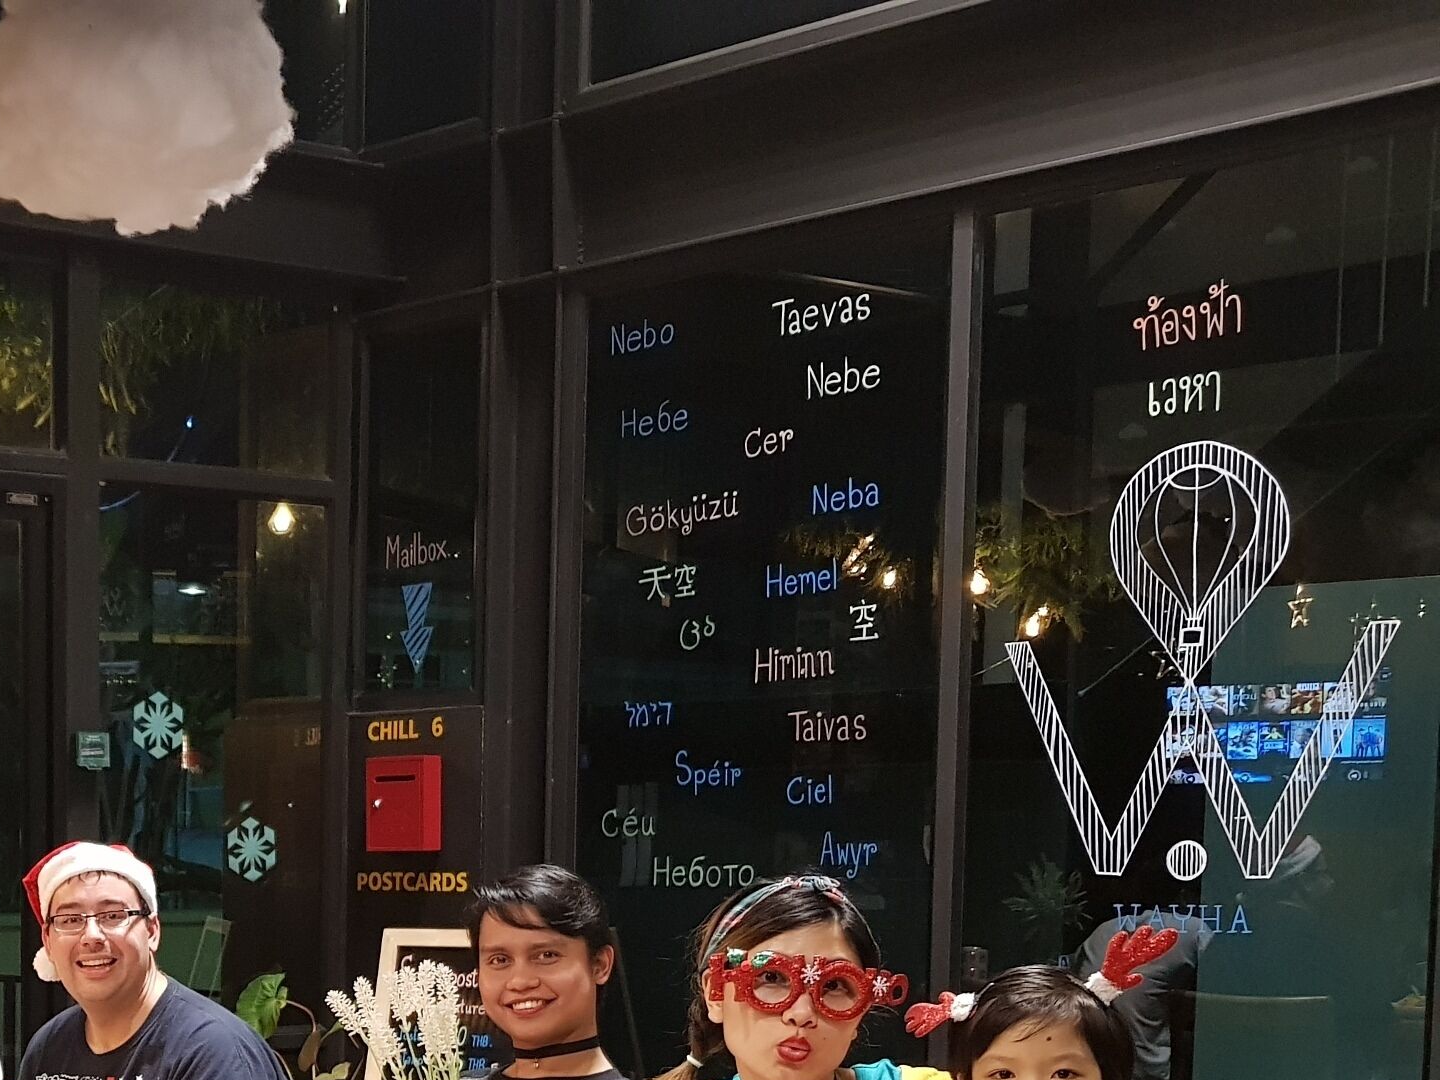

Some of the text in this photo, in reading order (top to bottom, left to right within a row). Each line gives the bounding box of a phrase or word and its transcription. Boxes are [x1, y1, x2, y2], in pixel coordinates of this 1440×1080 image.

[772, 293, 871, 336] Taevas
[1133, 279, 1242, 351] ท้องฟ้า
[611, 319, 675, 355] Nebo
[807, 357, 881, 399] Nebe
[1148, 370, 1221, 416] เวหา
[745, 427, 794, 458] Cer
[626, 491, 739, 536] Gökyüzü
[812, 478, 880, 515] Neba
[638, 564, 697, 600] 天空
[765, 559, 838, 598] Hemel
[849, 600, 879, 641] 空
[754, 646, 835, 684] Himinn
[367, 719, 419, 742] CHILL
[788, 710, 867, 743] Taivas
[675, 750, 742, 795] Spéir
[786, 775, 833, 805] Ciel
[601, 808, 655, 837] Céu
[820, 831, 878, 880] Awyr
[357, 871, 468, 892] POSTCARDS
[1113, 903, 1253, 934] WAYHA
